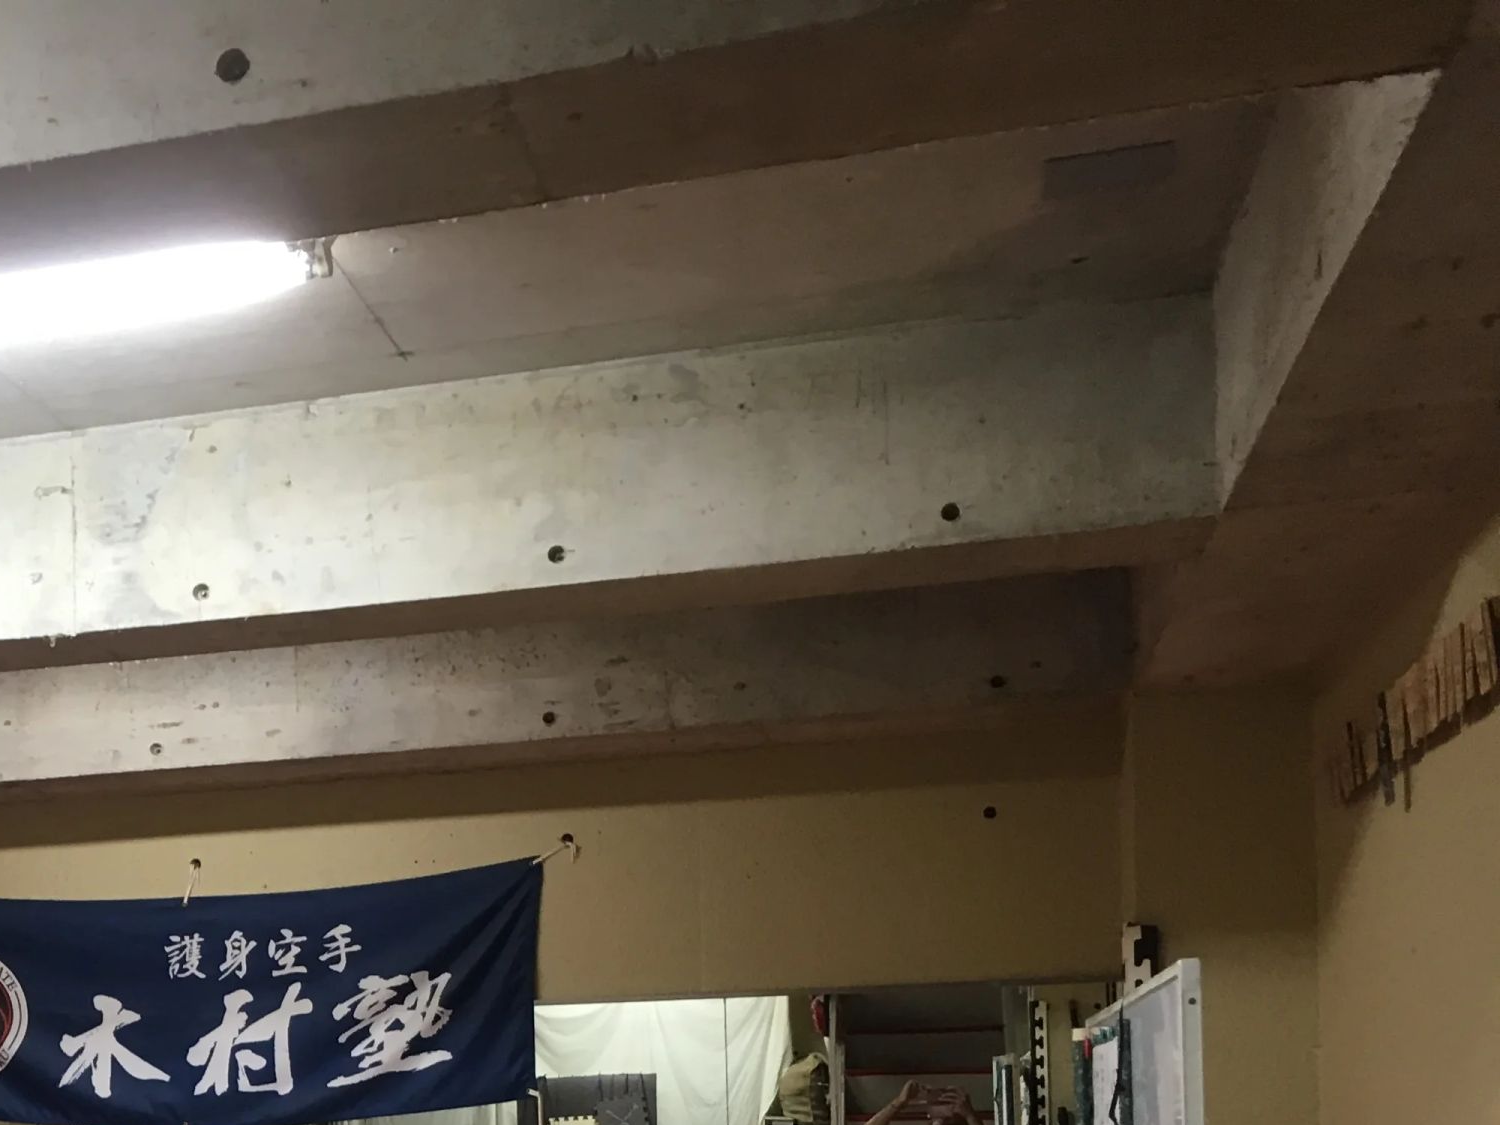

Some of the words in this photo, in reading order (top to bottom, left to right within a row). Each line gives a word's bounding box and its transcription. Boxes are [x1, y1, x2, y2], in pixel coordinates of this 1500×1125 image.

[164, 924, 362, 981] 護身空手
[58, 971, 453, 1098] 木村塾
